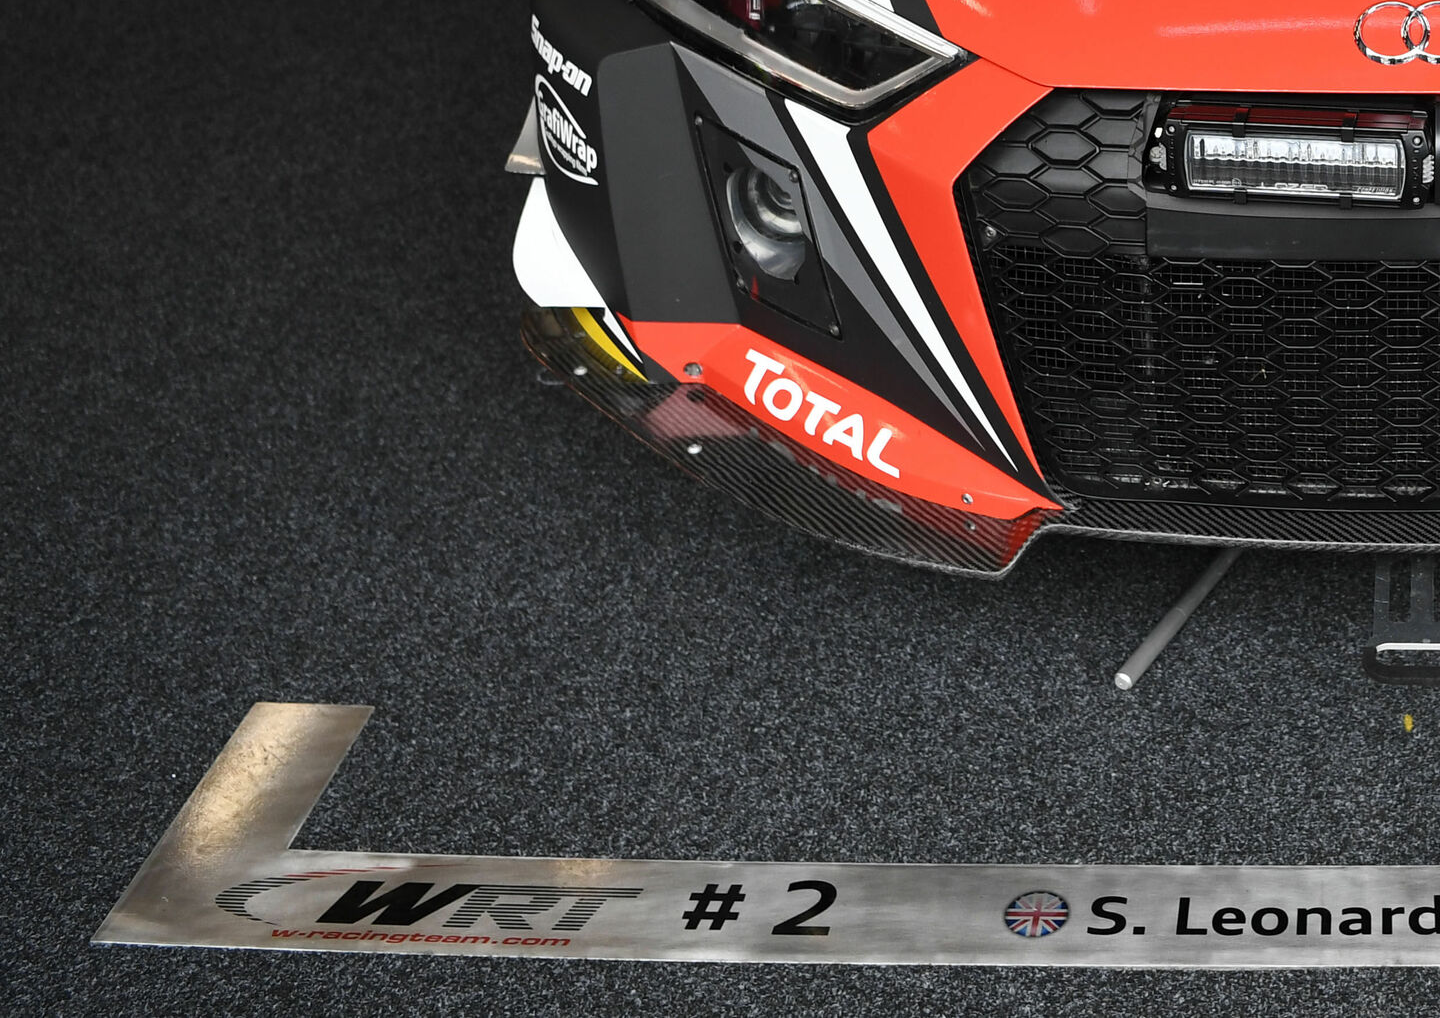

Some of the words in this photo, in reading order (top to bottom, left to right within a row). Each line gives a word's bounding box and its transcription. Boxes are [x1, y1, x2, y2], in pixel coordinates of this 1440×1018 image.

[531, 14, 592, 97] Snap-on
[744, 348, 899, 478] TOTAL
[315, 880, 644, 931] WRT
[772, 881, 837, 935] 2
[1086, 896, 1146, 935] S.
[271, 929, 571, 946] w-racingteam.com
